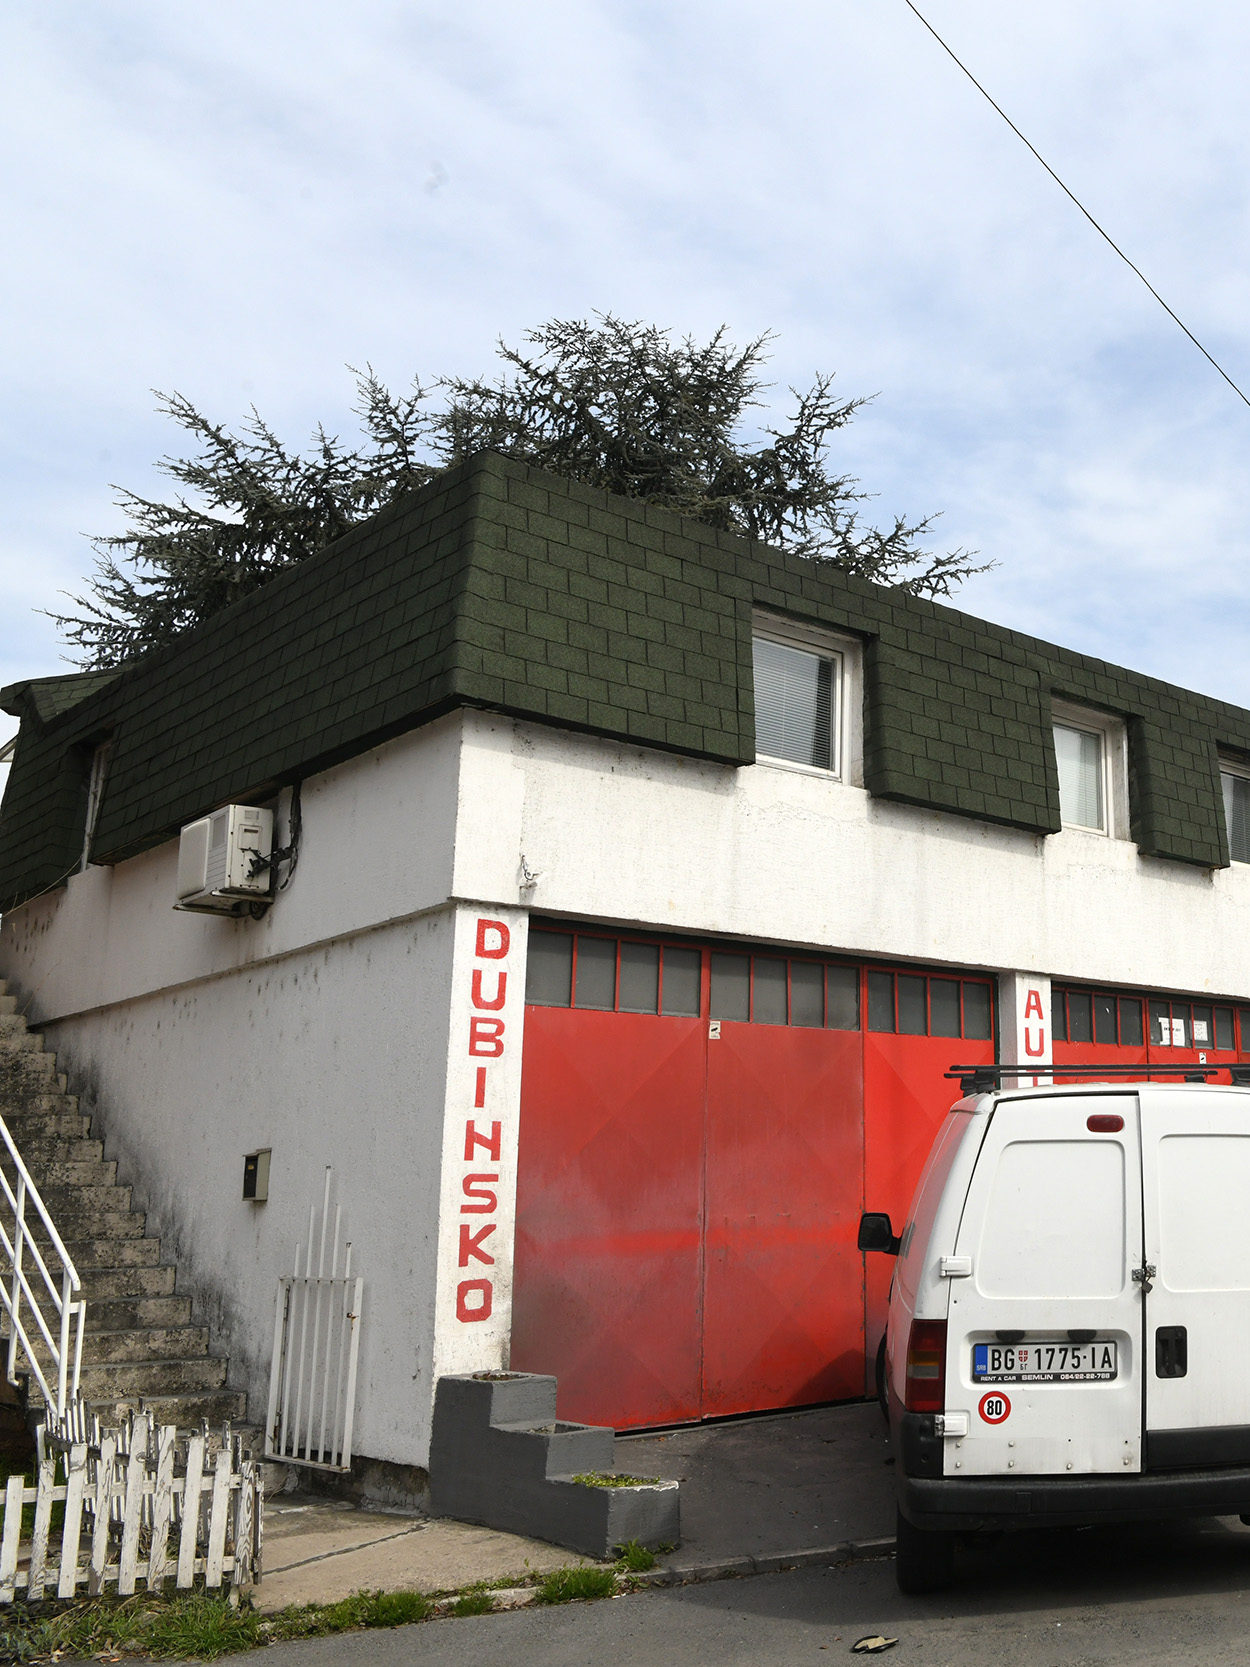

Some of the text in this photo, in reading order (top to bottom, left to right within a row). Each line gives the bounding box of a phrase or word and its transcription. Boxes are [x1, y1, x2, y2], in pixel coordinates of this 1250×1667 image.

[456, 918, 510, 1323] DUBINSKO
[991, 1348, 1015, 1371] BG
[986, 1399, 1003, 1416] 80
